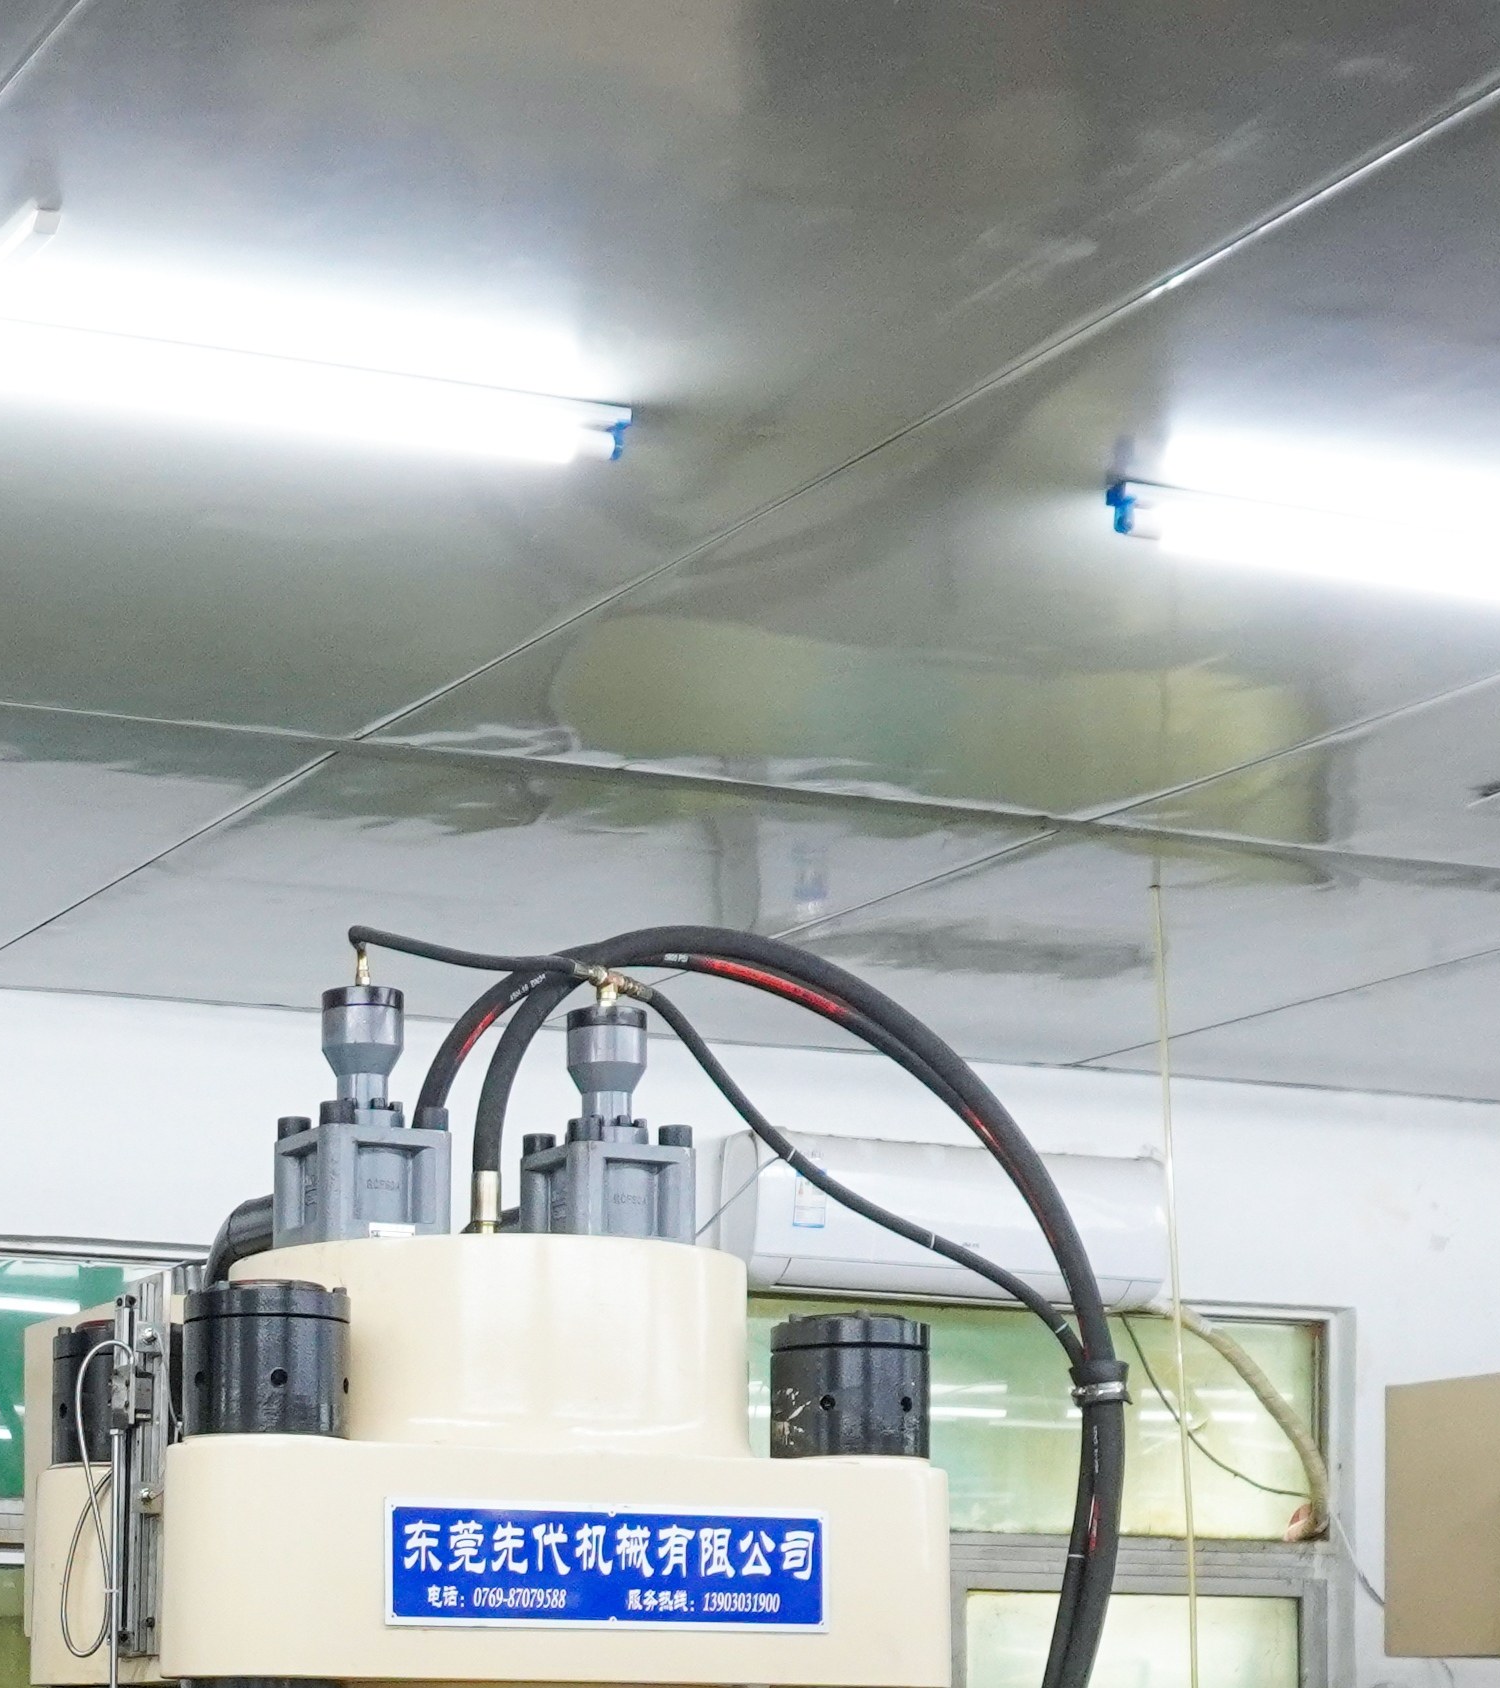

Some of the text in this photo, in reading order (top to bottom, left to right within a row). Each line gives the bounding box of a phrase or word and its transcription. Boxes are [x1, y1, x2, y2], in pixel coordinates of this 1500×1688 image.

[403, 1519, 816, 1581] 东莞先代机械有限公司
